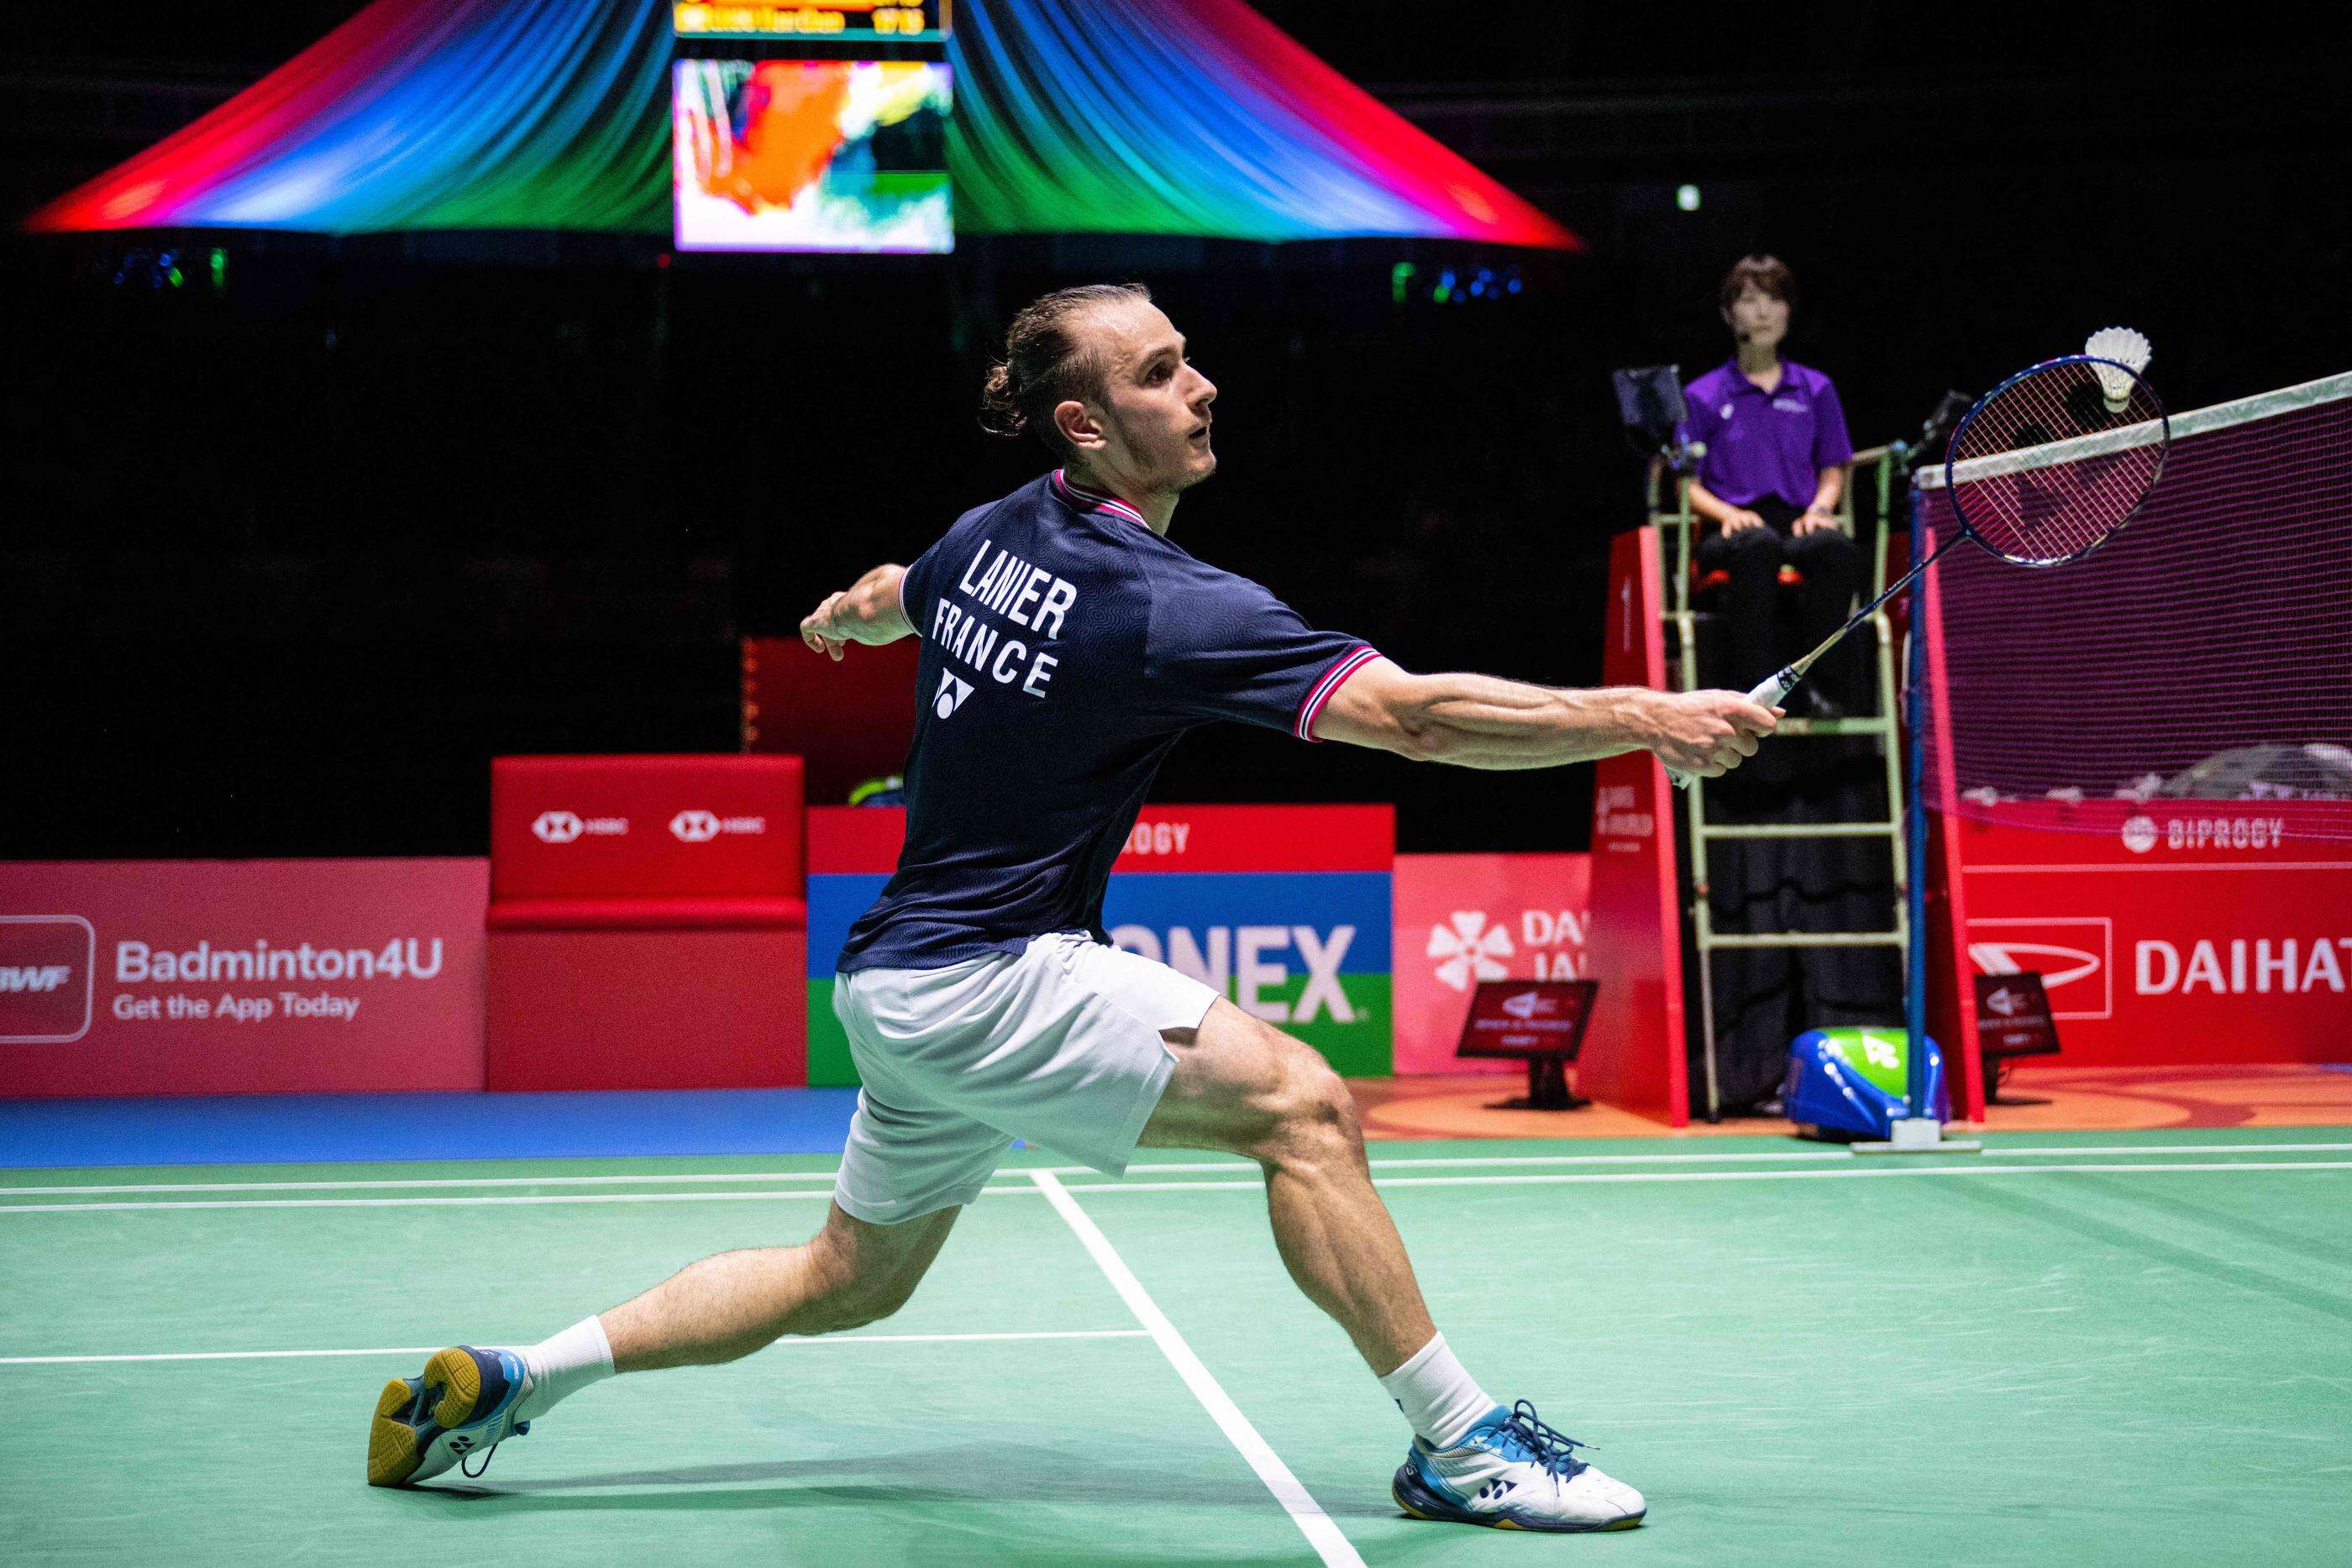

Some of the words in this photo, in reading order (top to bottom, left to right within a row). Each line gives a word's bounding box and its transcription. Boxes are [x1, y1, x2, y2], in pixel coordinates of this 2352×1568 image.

[959, 539, 1077, 640] LANIER
[932, 598, 1058, 698] FRANCE
[115, 936, 445, 983] Badminton4U
[113, 994, 160, 1020] Get
[167, 994, 209, 1018] the
[215, 994, 274, 1022] App
[280, 992, 360, 1022] Today
